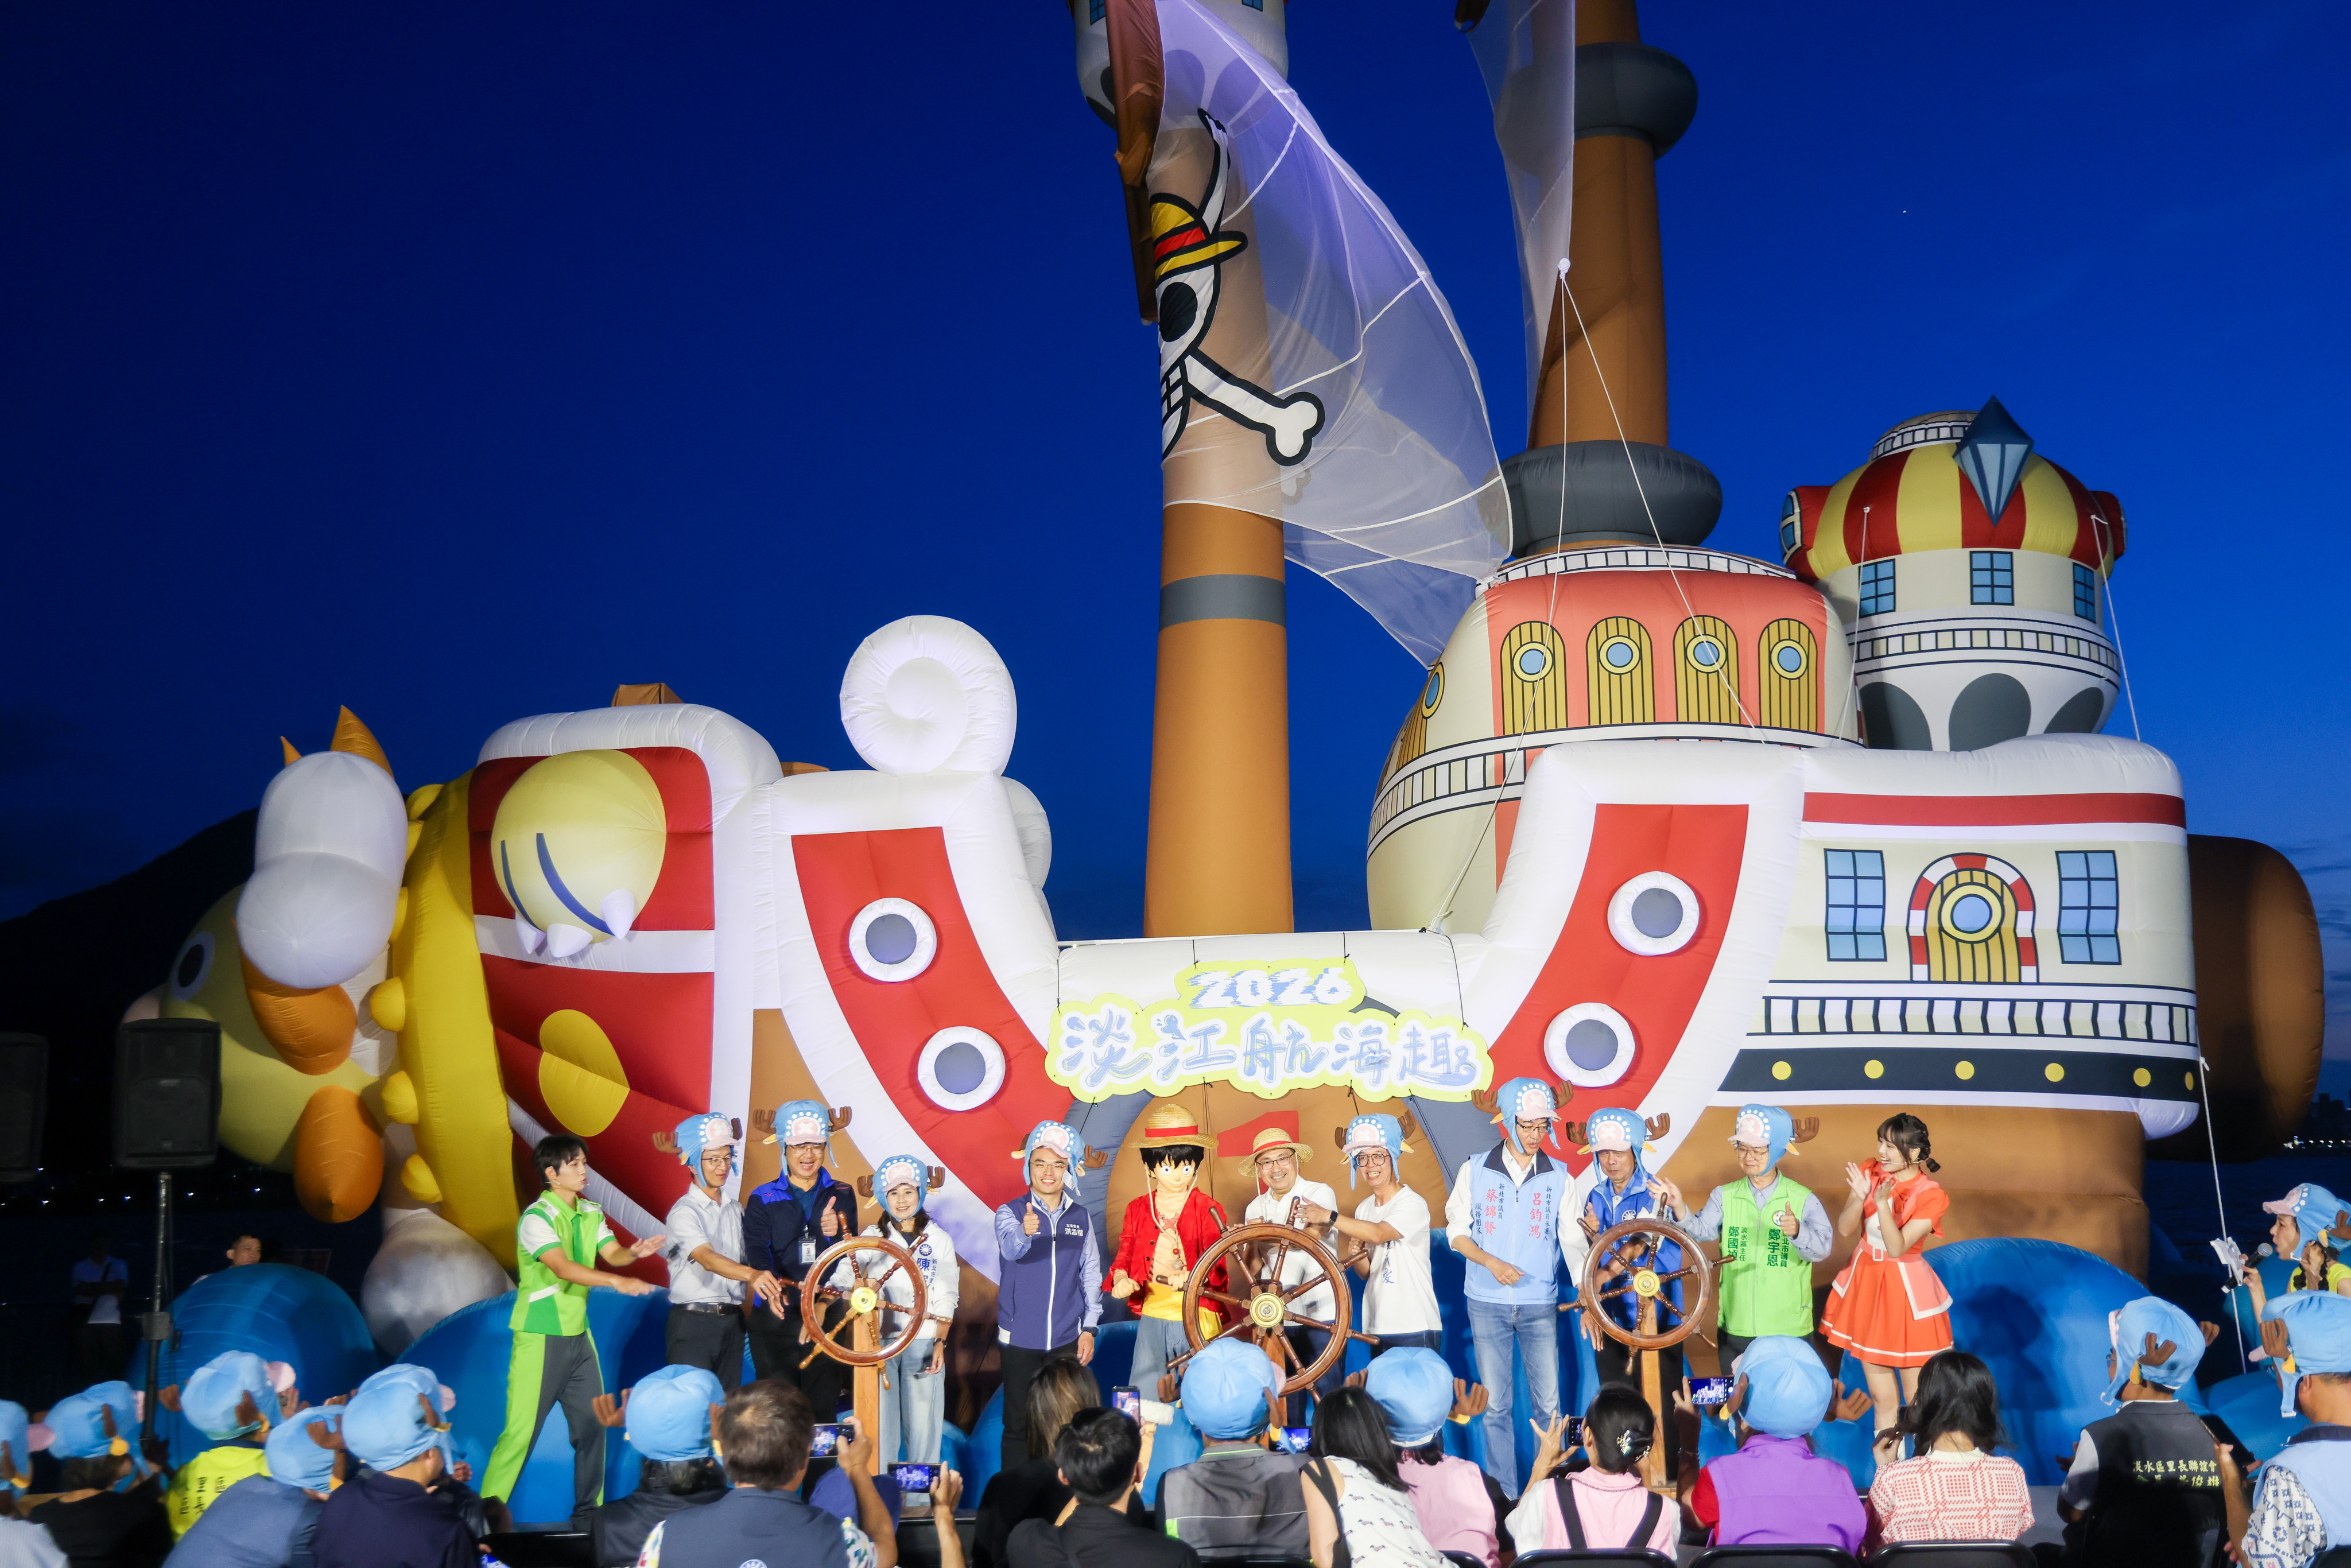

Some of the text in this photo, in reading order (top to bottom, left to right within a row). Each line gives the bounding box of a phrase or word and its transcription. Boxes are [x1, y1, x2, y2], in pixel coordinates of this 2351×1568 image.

[1185, 967, 1353, 1009] 2026
[1061, 1008, 1477, 1087] 淡江航海趣
[1484, 1188, 1499, 1235] 蔡錦賢
[1065, 1228, 1084, 1237] 洪孟楷
[1739, 1227, 1748, 1262] 淡水區主任
[1767, 1228, 1781, 1267] 鄭宇恩
